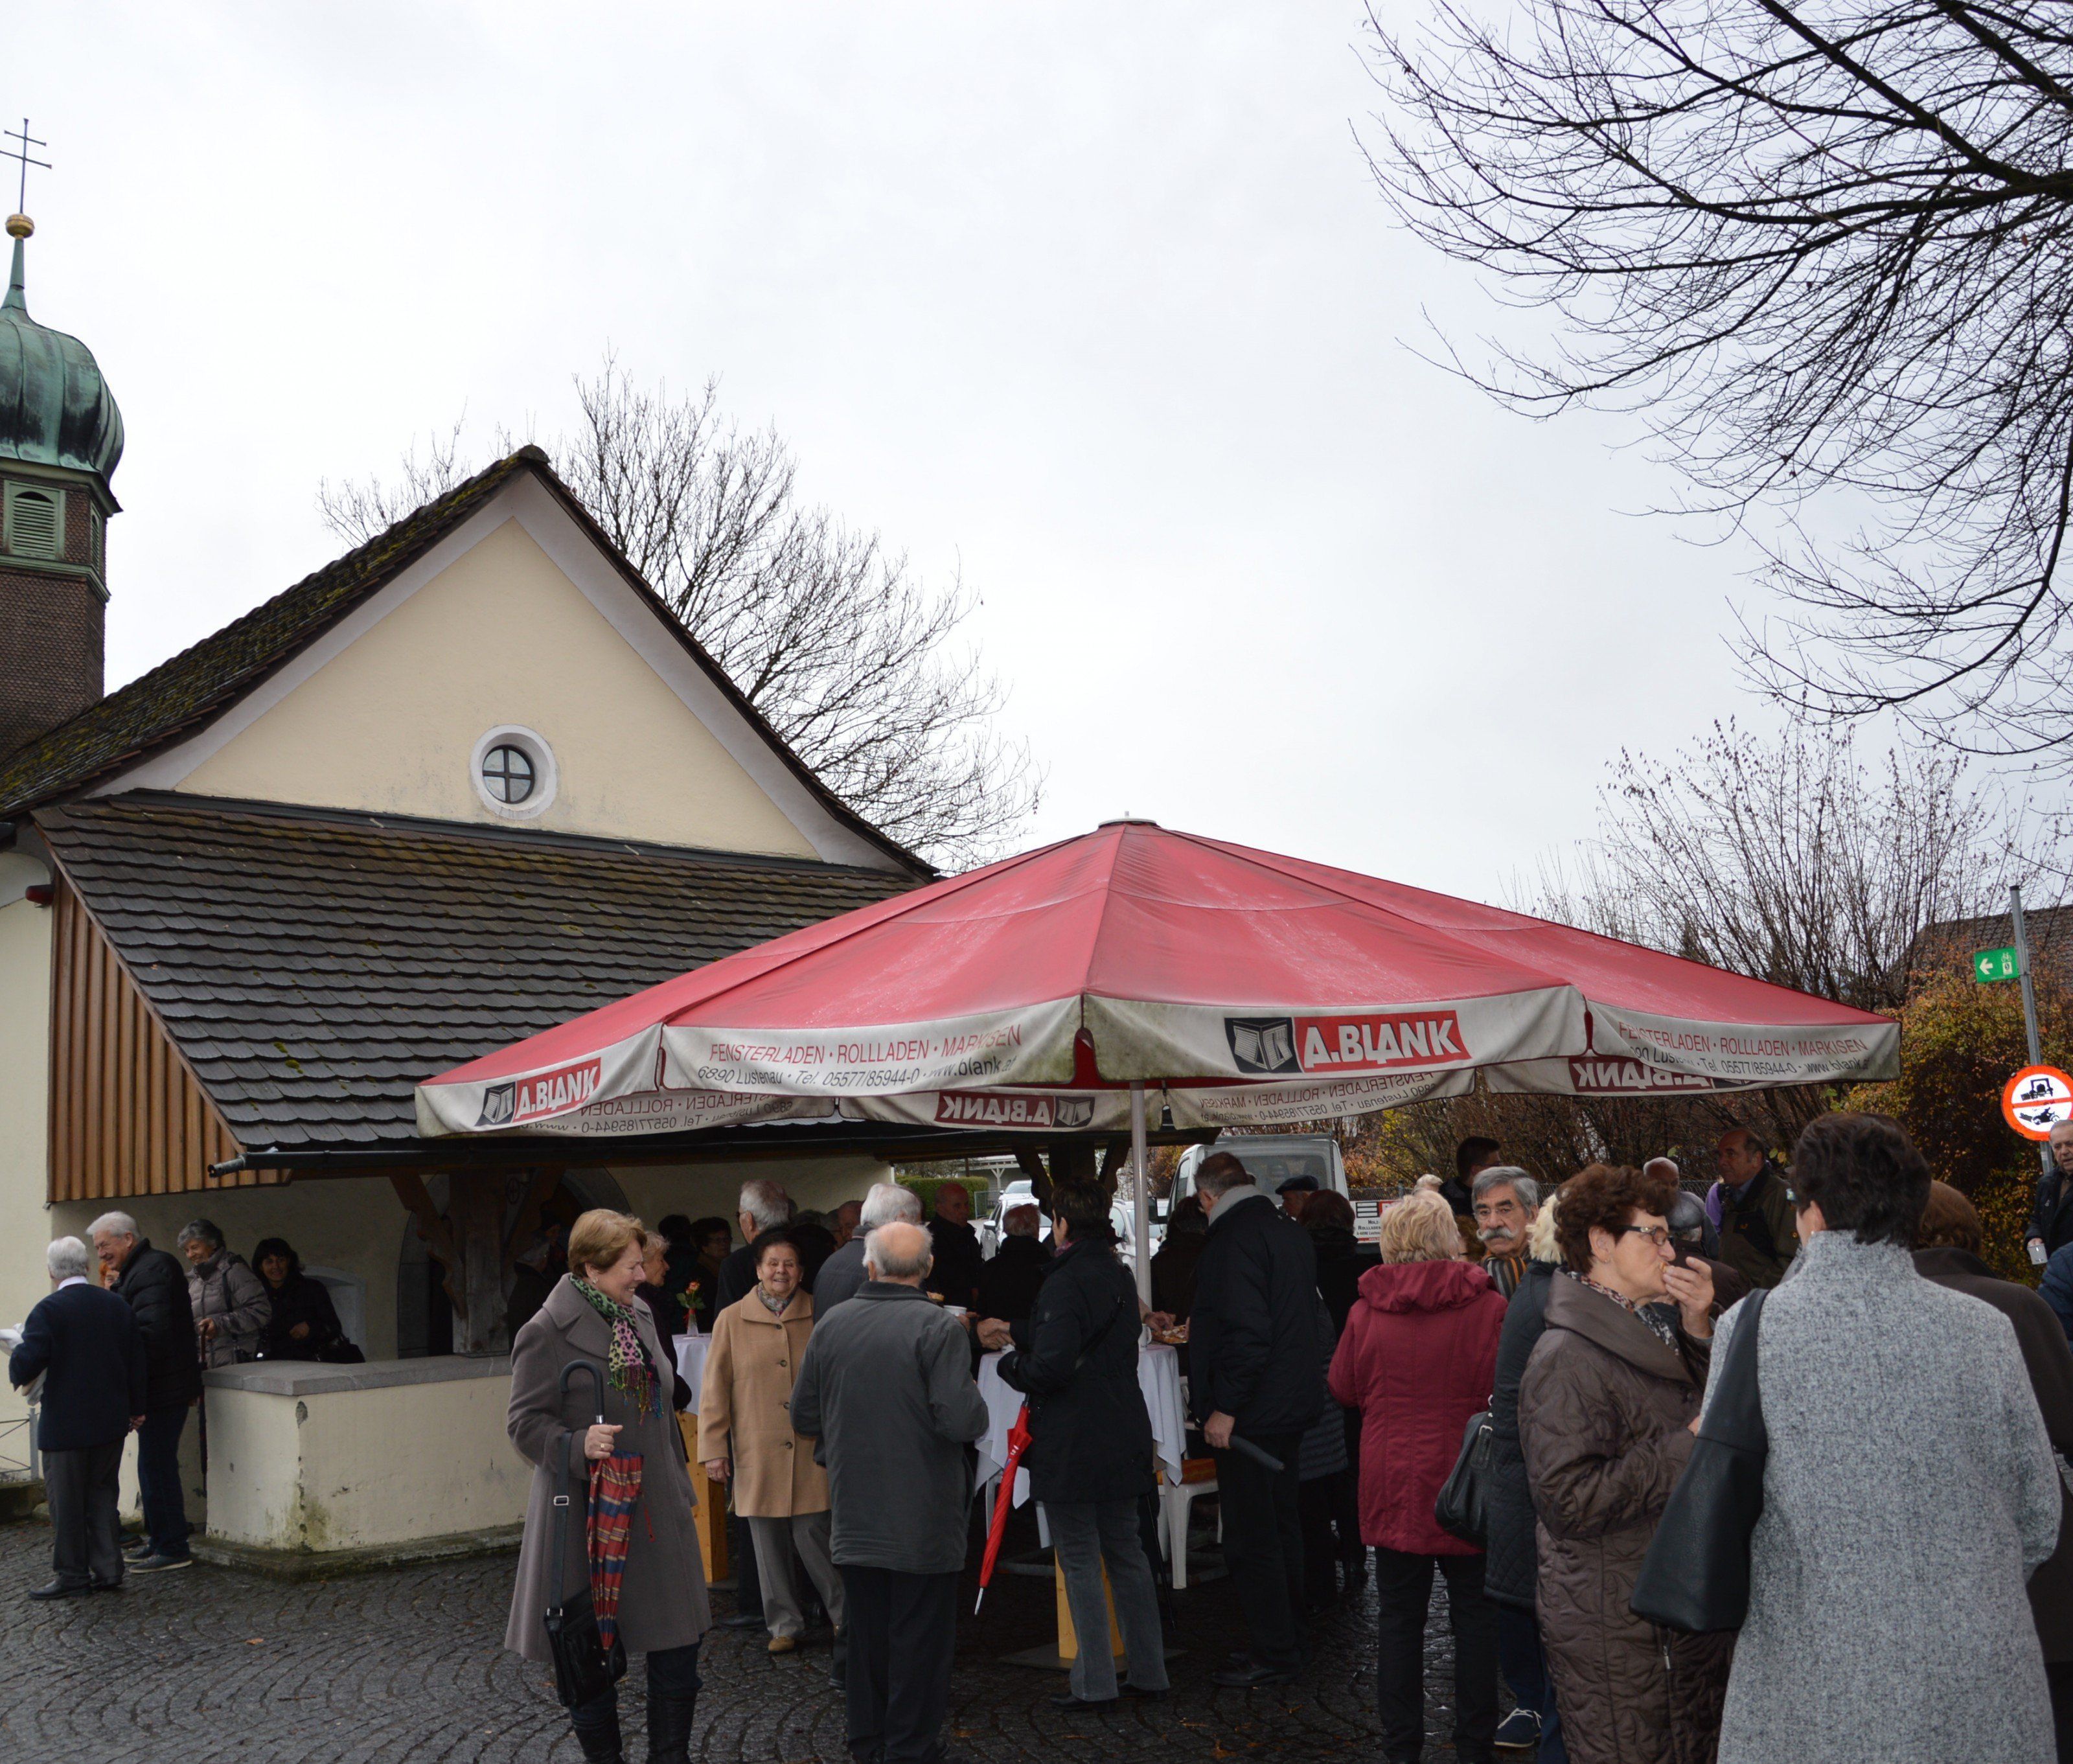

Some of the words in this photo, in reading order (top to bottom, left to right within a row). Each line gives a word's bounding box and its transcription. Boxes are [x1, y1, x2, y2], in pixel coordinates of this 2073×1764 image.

[709, 1044, 825, 1064] FENSTERLADEN
[836, 1040, 929, 1064] ROLLLADEN
[1304, 1019, 1461, 1068] A.BLANK
[1721, 1038, 1790, 1057] ROLLLADEN
[1798, 1039, 1868, 1056] MARKISEN
[698, 1066, 735, 1083] 6890
[736, 1070, 783, 1085] Lustenau
[795, 1070, 816, 1084] Tel.
[822, 1068, 919, 1087] 05577/85944-0
[1701, 1058, 1720, 1073] Tel.
[1721, 1060, 1796, 1075] 05577/85944-0
[515, 1066, 599, 1119] A.BLANK
